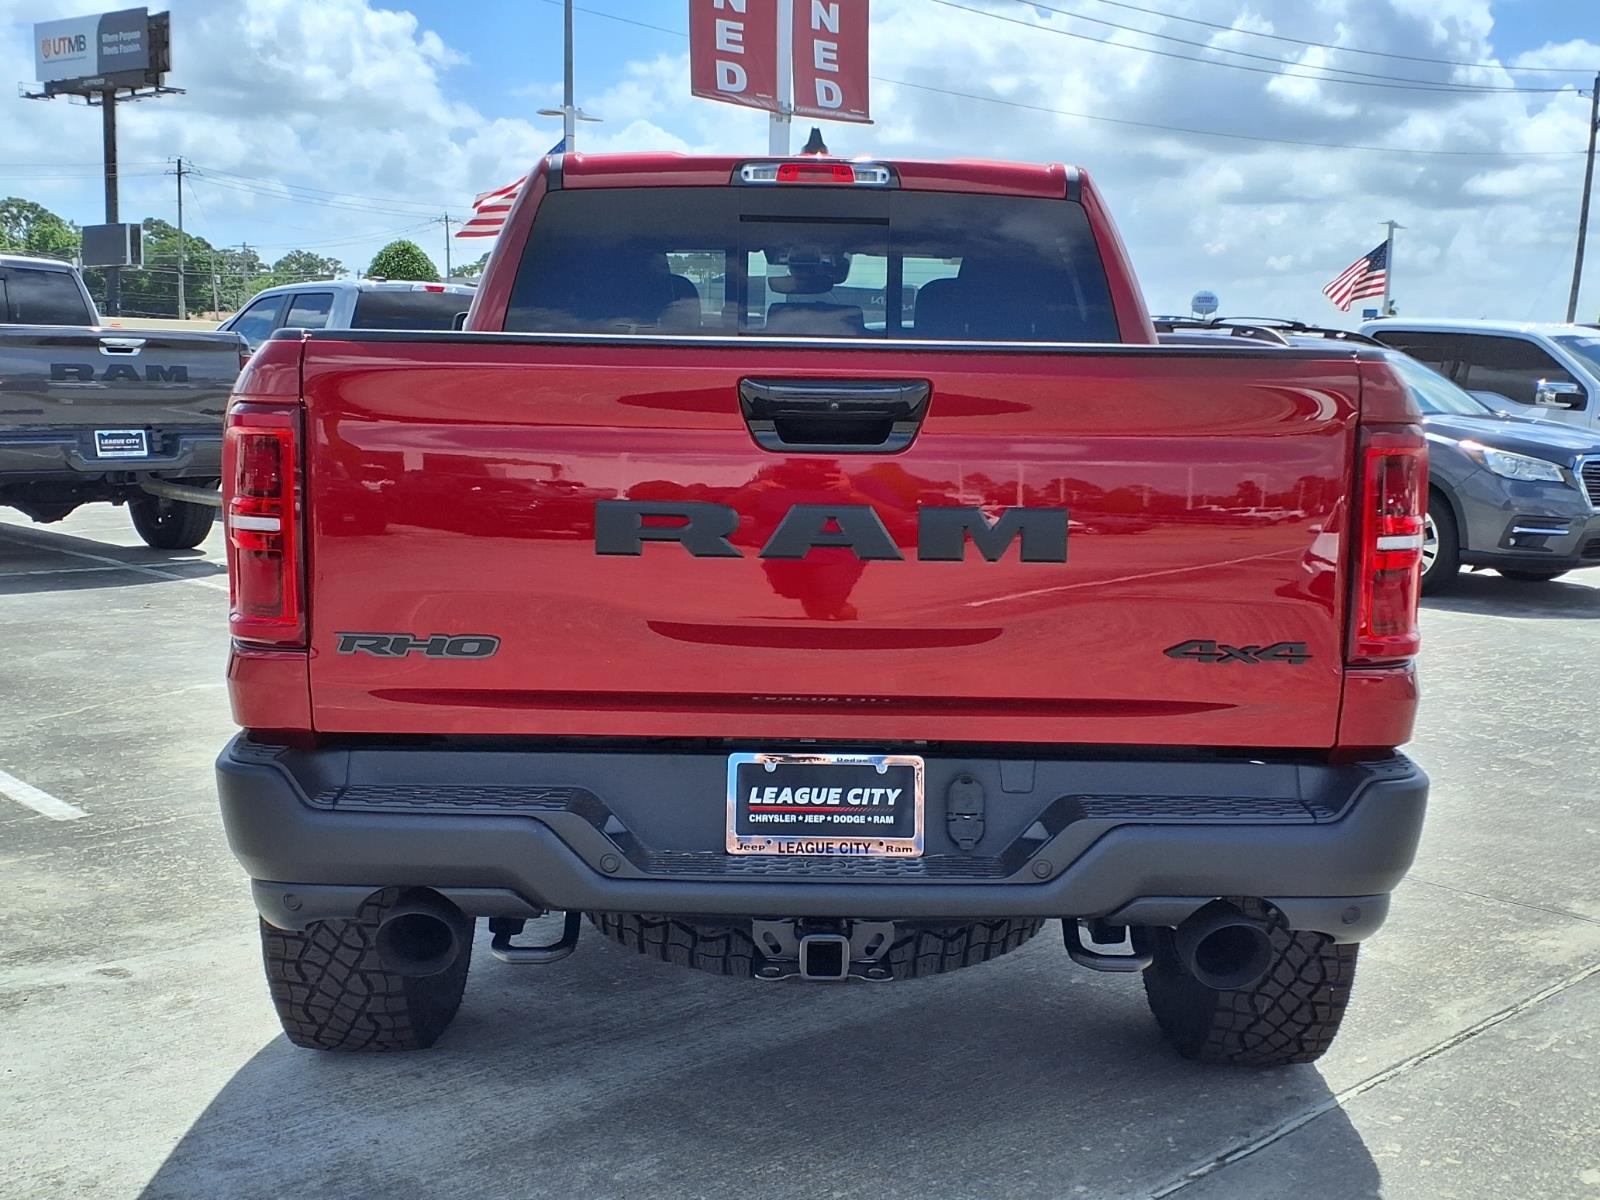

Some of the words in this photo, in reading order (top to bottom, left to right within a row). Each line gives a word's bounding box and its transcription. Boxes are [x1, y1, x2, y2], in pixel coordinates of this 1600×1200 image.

[52, 34, 87, 56] UTMB
[50, 363, 188, 382] RAM
[595, 500, 1069, 563] RAM
[335, 632, 501, 660] RHO
[1163, 639, 1313, 665] 4x4
[749, 786, 842, 805] LEAGUE
[846, 788, 902, 806] CITY
[749, 814, 797, 824] CHRYSLER
[803, 815, 826, 824] JEEP
[833, 815, 866, 824] DODGE
[873, 815, 894, 825] RAM
[736, 842, 766, 853] Jeep
[778, 841, 834, 855] LEAGUE
[839, 842, 872, 855] CITY
[886, 845, 913, 854] Ram
